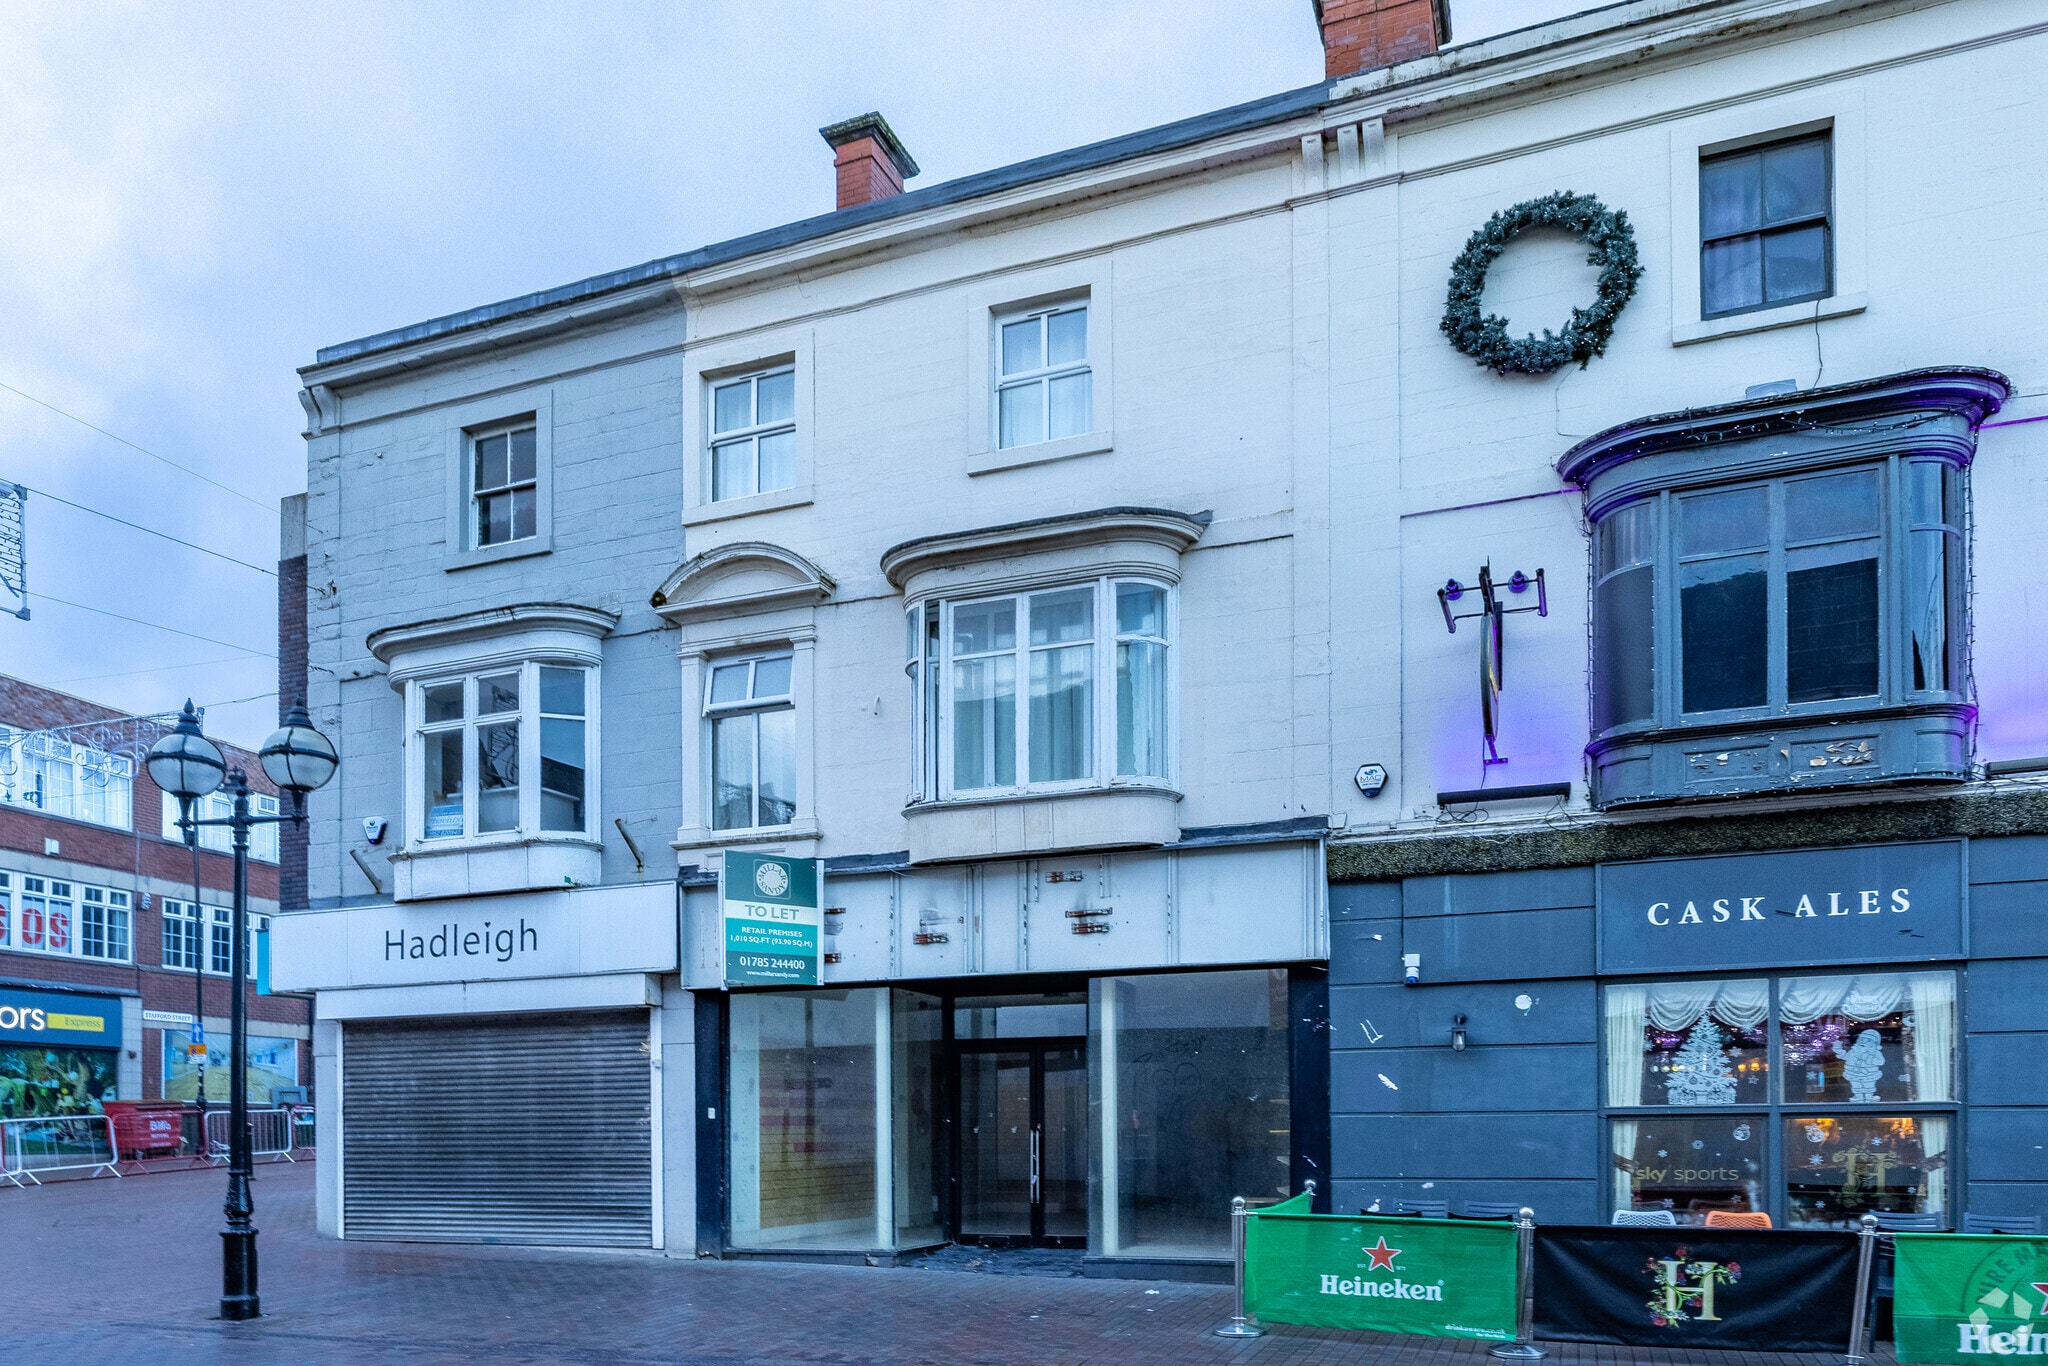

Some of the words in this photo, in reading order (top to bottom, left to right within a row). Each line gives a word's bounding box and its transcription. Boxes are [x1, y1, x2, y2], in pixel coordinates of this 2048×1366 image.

[758, 864, 787, 881] MILLAR
[758, 880, 786, 894] SANDY
[745, 905, 767, 917] TO
[772, 908, 799, 920] LET
[1647, 897, 1766, 926] CASK
[1795, 888, 1910, 918] ALES
[385, 918, 538, 962] Hadleigh
[741, 926, 767, 936] RETAIL
[768, 927, 803, 938] PREMISES
[730, 934, 748, 942] 1,010
[771, 937, 792, 947] (93.90
[740, 956, 768, 967] 01785
[771, 957, 805, 970] 244400
[0, 1005, 46, 1031] ors
[65, 1016, 101, 1029] Express
[145, 1011, 172, 1019] STAFFORD
[172, 1014, 191, 1022] STREET
[1635, 1166, 1667, 1183] sky
[1673, 1167, 1740, 1183] sports
[1319, 1274, 1444, 1302] Heineken
